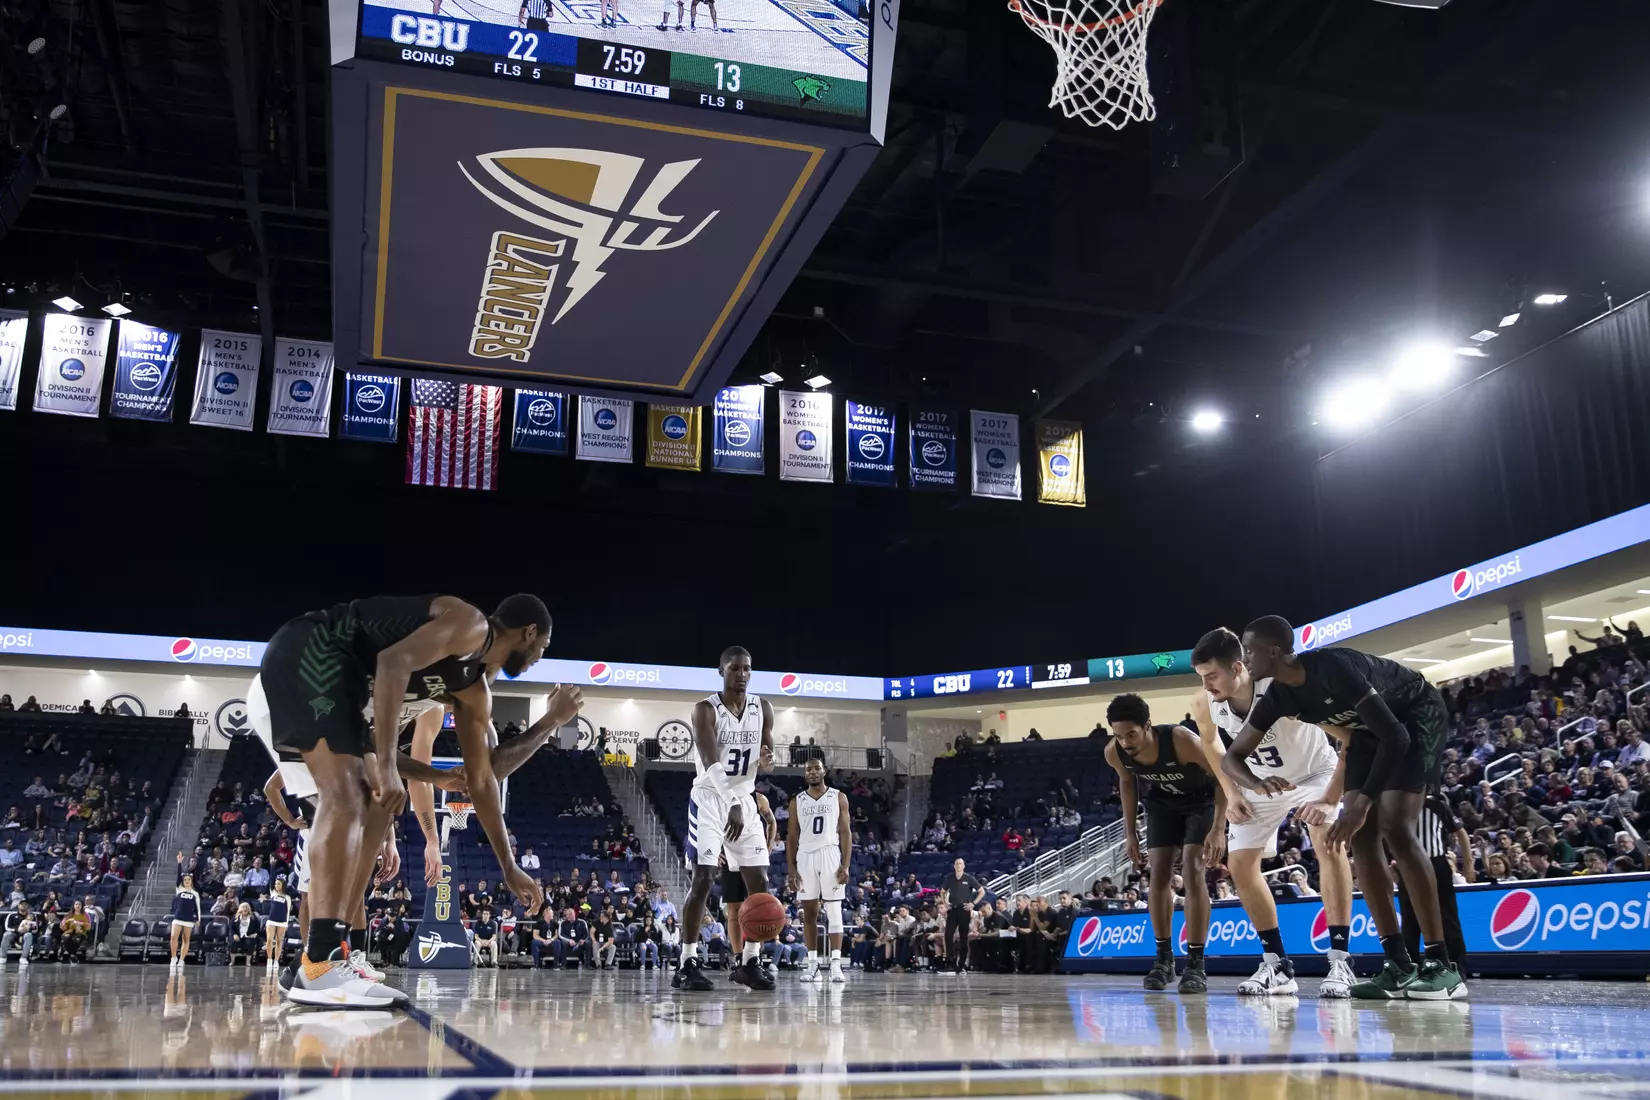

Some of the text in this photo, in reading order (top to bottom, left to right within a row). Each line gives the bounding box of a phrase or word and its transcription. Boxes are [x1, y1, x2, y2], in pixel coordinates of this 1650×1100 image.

[391, 13, 470, 52] CBU
[507, 30, 539, 62] 22
[402, 49, 455, 66] BONUS
[602, 45, 646, 75] 7:59
[494, 63, 541, 79] FLS 5
[714, 62, 741, 92] 13
[591, 77, 659, 97] 1ST HALF
[700, 94, 744, 111] FLS 8
[468, 230, 567, 363] LANCERS
[60, 324, 95, 337] 2016
[61, 338, 89, 346] MEN'S
[140, 331, 169, 342] 016
[133, 342, 162, 352] MEN'S
[214, 338, 248, 351] 2015
[51, 346, 103, 357] ASKETBALL
[120, 349, 174, 362] BASKETBALL
[215, 352, 242, 361] MEN'S
[288, 347, 320, 359] 2014
[202, 359, 256, 371] BASKETBALL
[289, 360, 316, 369] MEN'S
[61, 367, 84, 377] NCAA
[276, 368, 330, 378] BASKETBALL
[346, 373, 398, 384] BASKETBALL
[48, 384, 84, 393] DIVISION
[216, 382, 238, 390] NCAA
[39, 391, 97, 403] TOURNAMENT
[115, 392, 171, 404] TOURNAMENT
[292, 389, 313, 397] NCAA
[516, 389, 567, 399] BASKETBALL
[117, 401, 167, 412] CHAMPIONS
[200, 397, 241, 407] DIVISION
[582, 397, 631, 407] BASKETBALL
[717, 401, 757, 411] WOME
[202, 407, 244, 417] SWEET 16
[280, 406, 314, 414] DIVISION
[650, 403, 699, 414] BASKETBALL
[857, 404, 886, 416] 2017
[272, 412, 326, 422] TOURNAMENT
[343, 414, 395, 425] CHAMPIONS
[852, 415, 889, 425] WOMEN'S
[919, 411, 948, 423] 2017
[783, 419, 829, 429] BASKETBALL
[848, 422, 895, 434] BASKETBALL
[915, 423, 950, 432] WOMEN'S
[981, 418, 1008, 430] 2017
[515, 427, 566, 438] CHAMPIONS
[665, 426, 686, 434] NCAA
[911, 429, 957, 440] BASKETBALL
[976, 429, 1012, 438] WOMEN'S
[1045, 426, 1072, 437] 2017
[581, 432, 600, 440] WEST
[582, 440, 627, 449] CHAMPIONS
[652, 441, 688, 450] DIVISION
[974, 437, 1018, 448] BASKETBALL
[653, 448, 694, 457] NATIONAL
[714, 448, 761, 458] CHAMPIONS
[789, 454, 818, 462] DIVISION
[650, 455, 697, 465] RUNNER UP
[783, 460, 830, 469] TOURNAMENT
[849, 461, 895, 471] CHAMPIONS
[912, 467, 957, 478] TOURNAMENT
[995, 472, 1018, 481] REGION
[915, 474, 955, 485] CHAMPIONS
[978, 478, 1016, 487] CHAMPIONS
[1475, 555, 1522, 590] pepsi
[1317, 614, 1353, 642] pepsi
[199, 644, 252, 661] pepsi
[1047, 663, 1072, 679] 7:59
[1106, 659, 1124, 678] 13
[614, 669, 661, 684] pepsi
[910, 678, 915, 686] 4
[997, 670, 1014, 688] 22
[803, 679, 848, 694] pepsi
[933, 674, 971, 694] CBU
[910, 688, 915, 697] 5
[159, 709, 209, 718] BIBALLY
[606, 731, 639, 739] QUIPPED
[725, 748, 751, 776] 31
[1139, 772, 1185, 782] HICAGO
[813, 816, 824, 834] 0
[435, 865, 452, 921] CBU
[1541, 891, 1650, 941] pepsi
[1098, 919, 1147, 951] pepsi
[1204, 916, 1260, 949] peps
